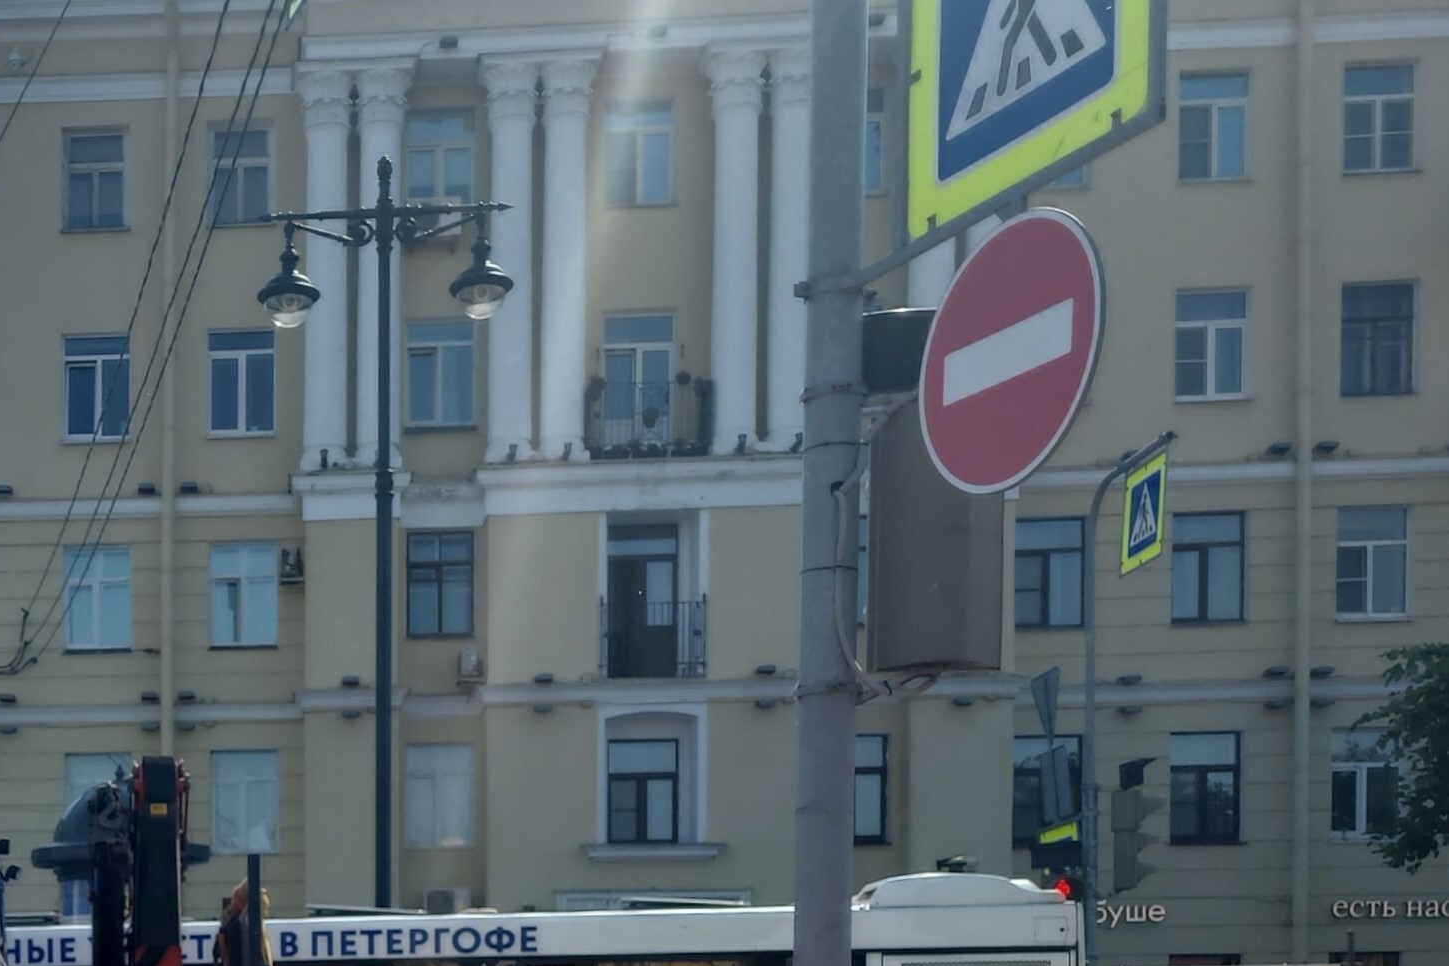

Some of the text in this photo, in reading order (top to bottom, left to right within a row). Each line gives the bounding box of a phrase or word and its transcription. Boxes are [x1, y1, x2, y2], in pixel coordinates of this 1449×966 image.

[1332, 900, 1396, 918] есть
[7, 938, 76, 964] НЫЕ
[280, 931, 299, 956] В
[312, 925, 538, 957] ПЕТЕРГОФЕ
